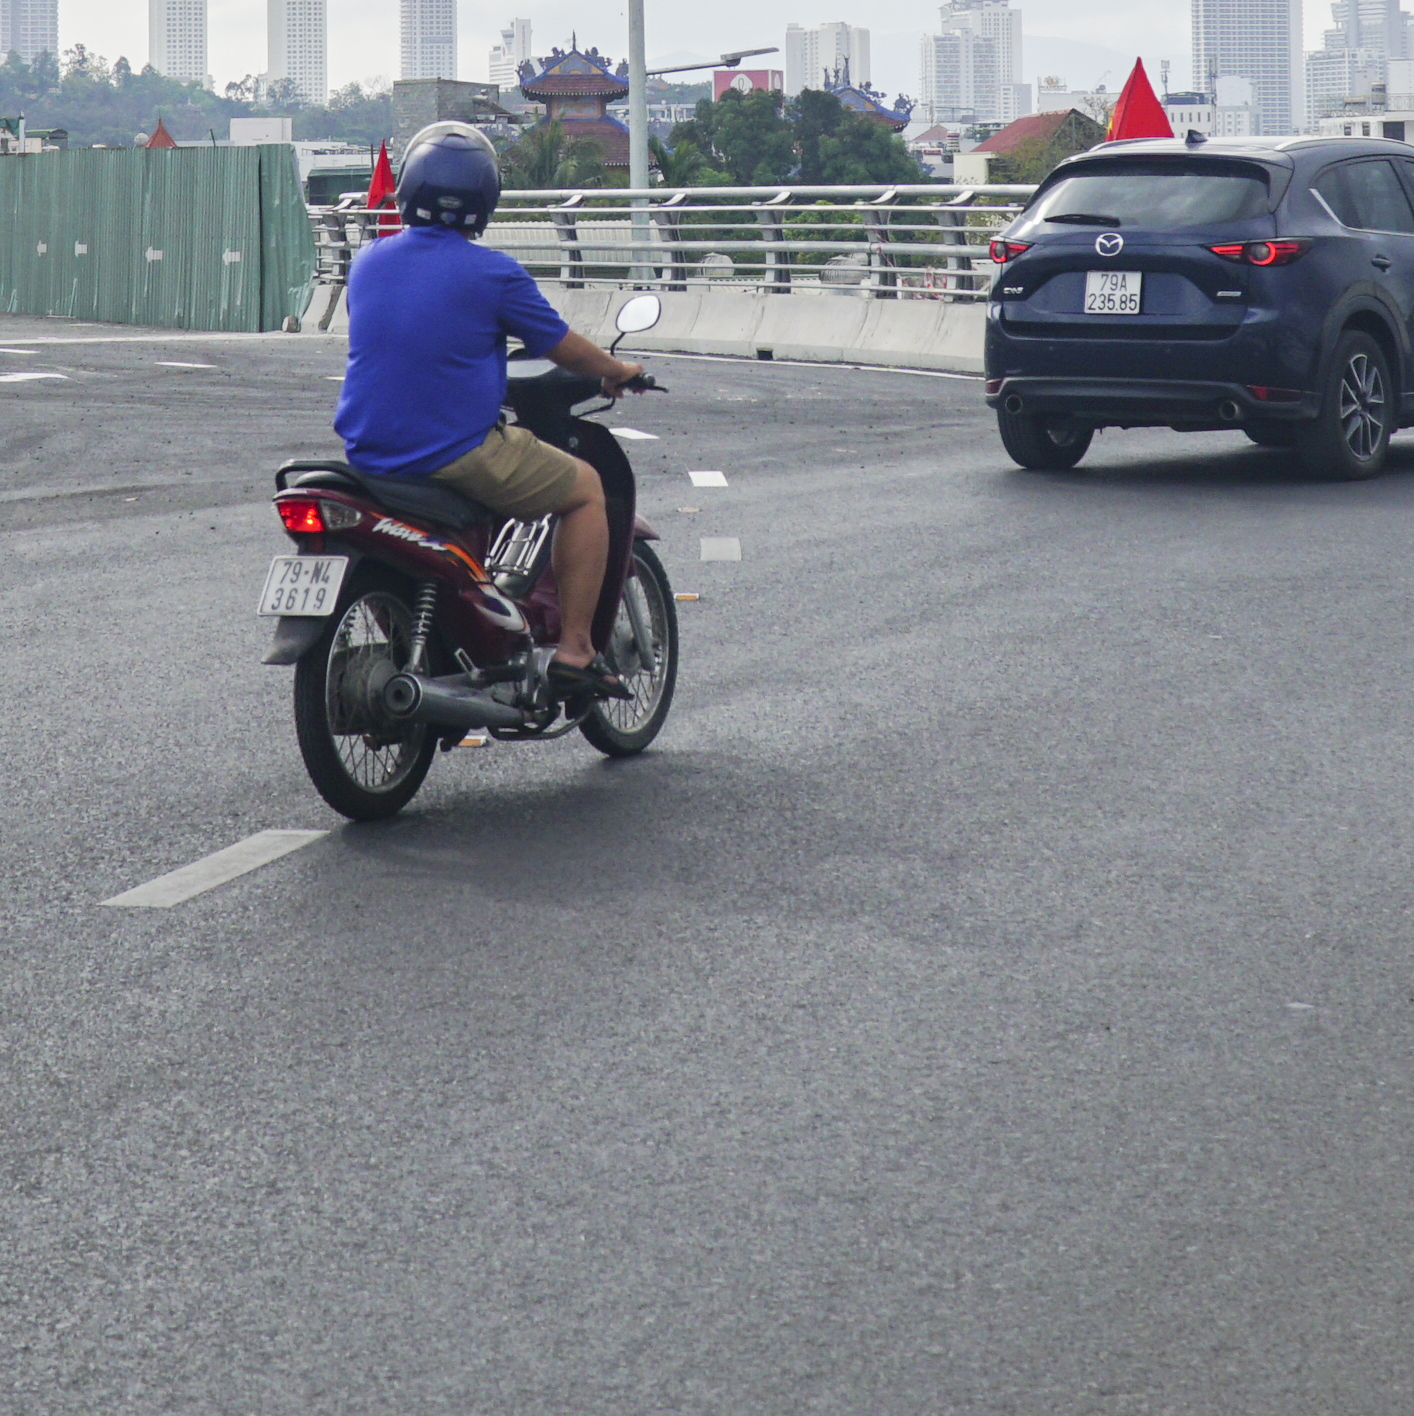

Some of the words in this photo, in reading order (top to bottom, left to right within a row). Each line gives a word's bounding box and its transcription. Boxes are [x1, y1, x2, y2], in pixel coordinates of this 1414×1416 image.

[1099, 273, 1128, 292] 79A
[1087, 293, 1139, 312] 235.85
[279, 560, 332, 584] 79-N4
[271, 587, 327, 611] 3619
